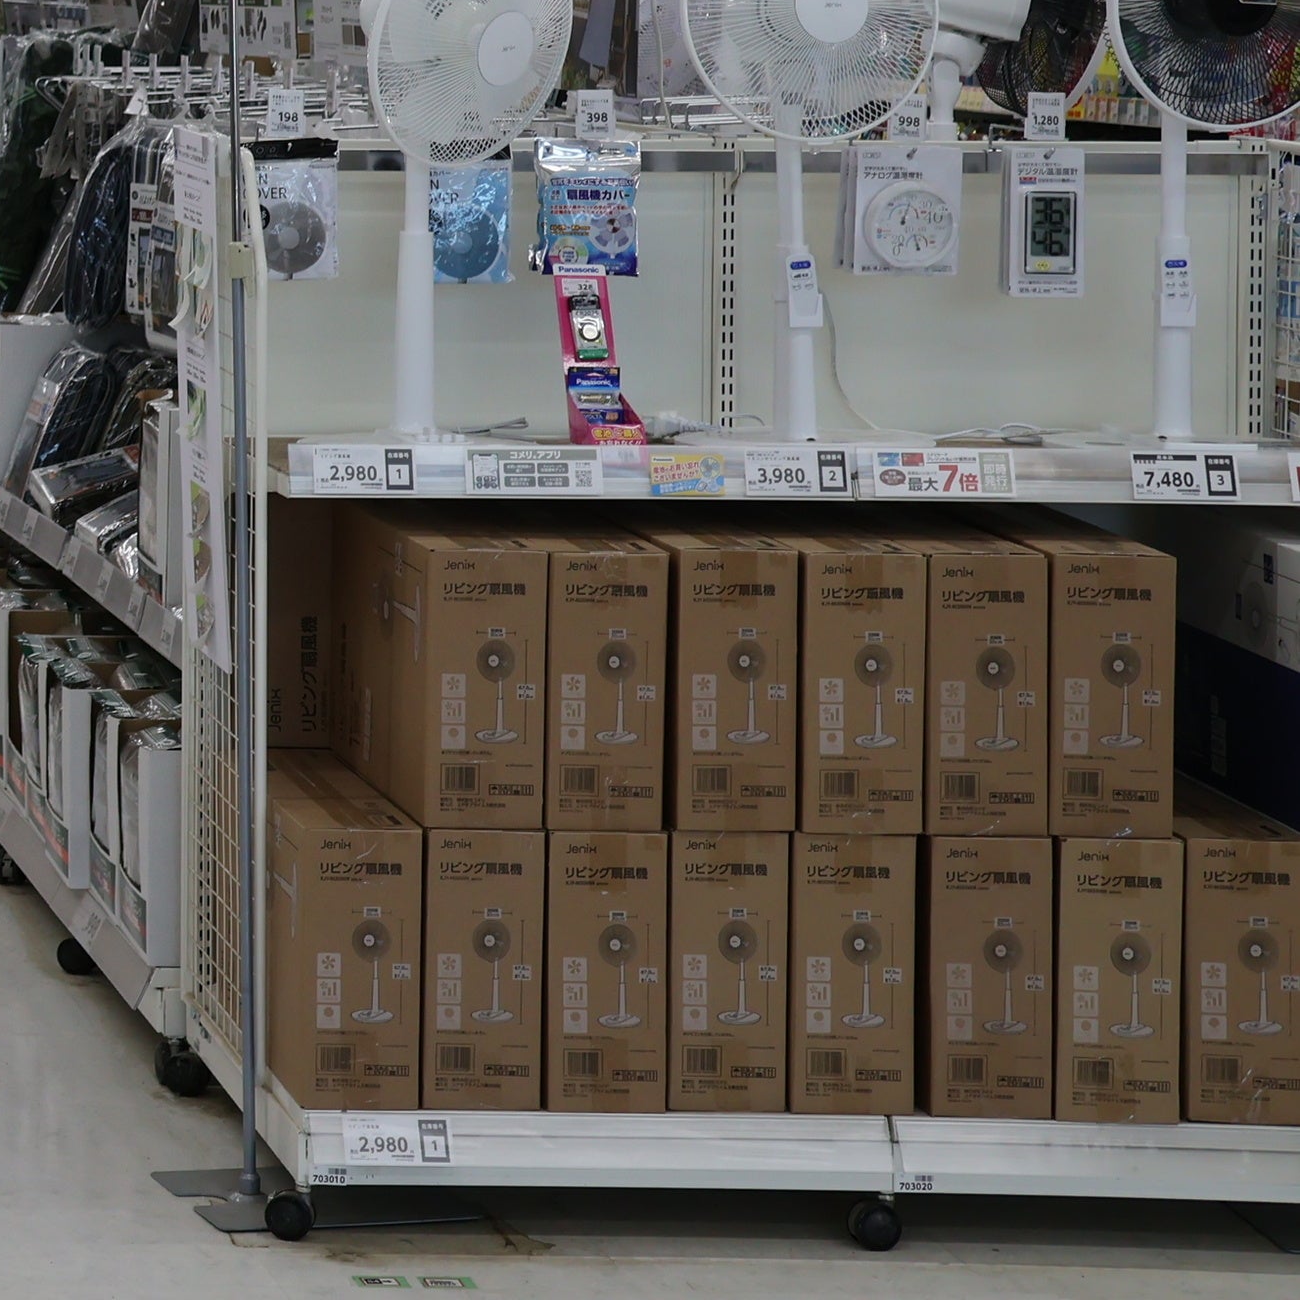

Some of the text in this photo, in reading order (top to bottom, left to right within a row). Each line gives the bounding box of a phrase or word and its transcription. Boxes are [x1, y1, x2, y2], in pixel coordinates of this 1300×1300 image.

[329, 465, 378, 483] 2,980
[757, 466, 806, 485] 3,980
[1144, 471, 1194, 489] 7,480
[444, 559, 475, 571] Jenix
[1204, 846, 1236, 859] Jenix
